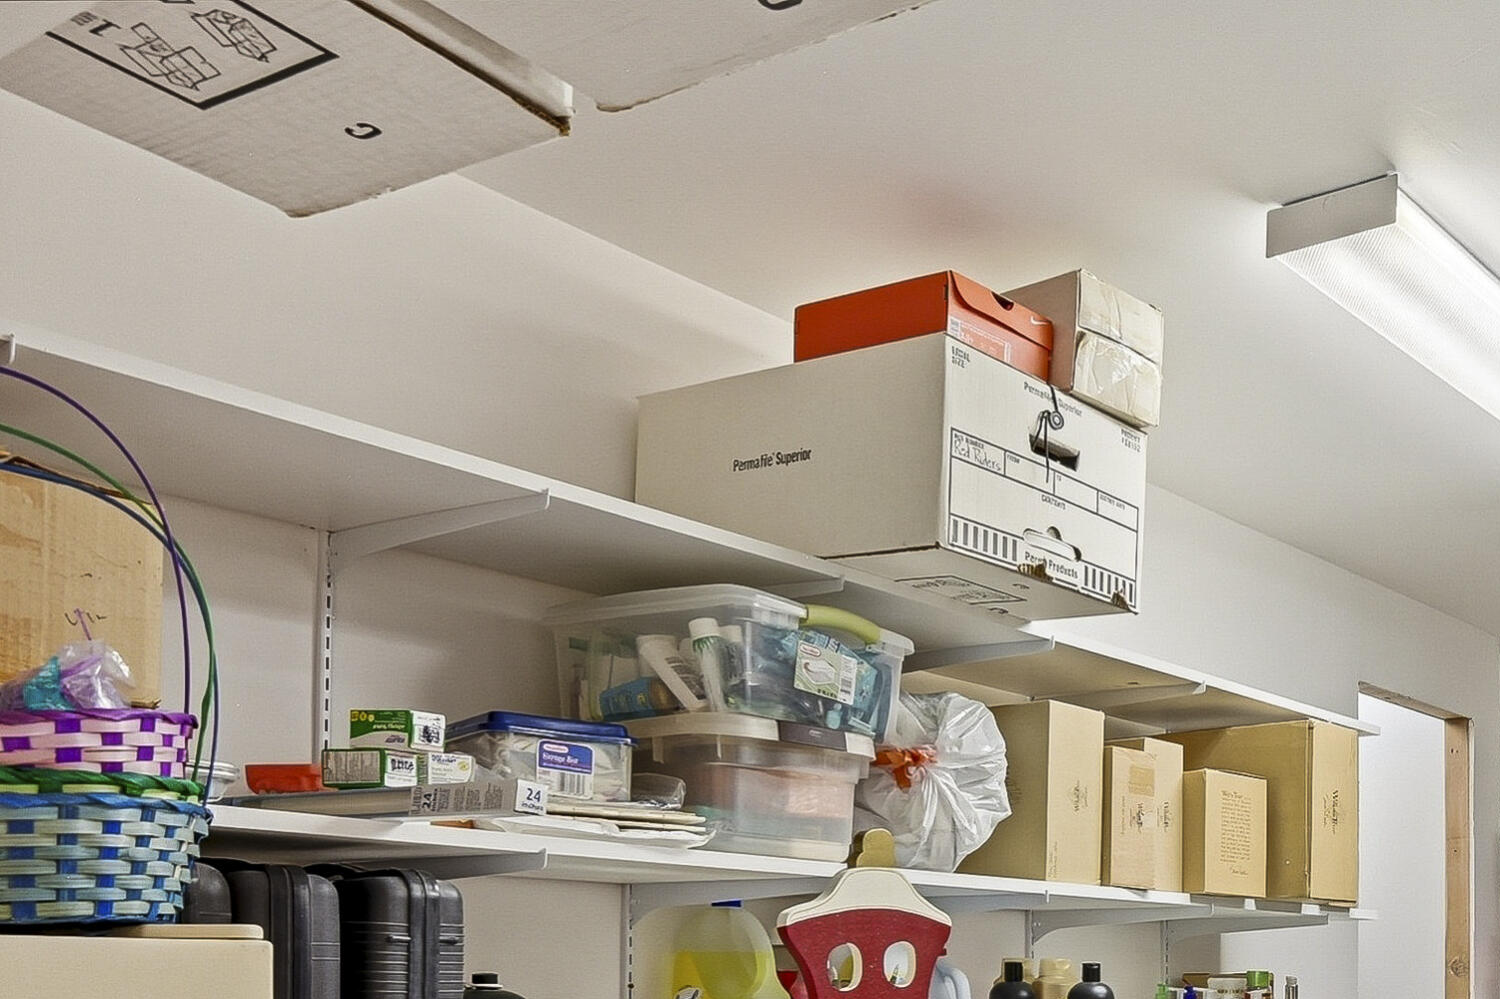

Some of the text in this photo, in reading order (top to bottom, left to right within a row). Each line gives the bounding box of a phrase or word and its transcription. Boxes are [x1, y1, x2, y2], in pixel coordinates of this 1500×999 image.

[775, 447, 812, 465] Superior
[1047, 558, 1080, 580] Products
[526, 787, 542, 802] 24
